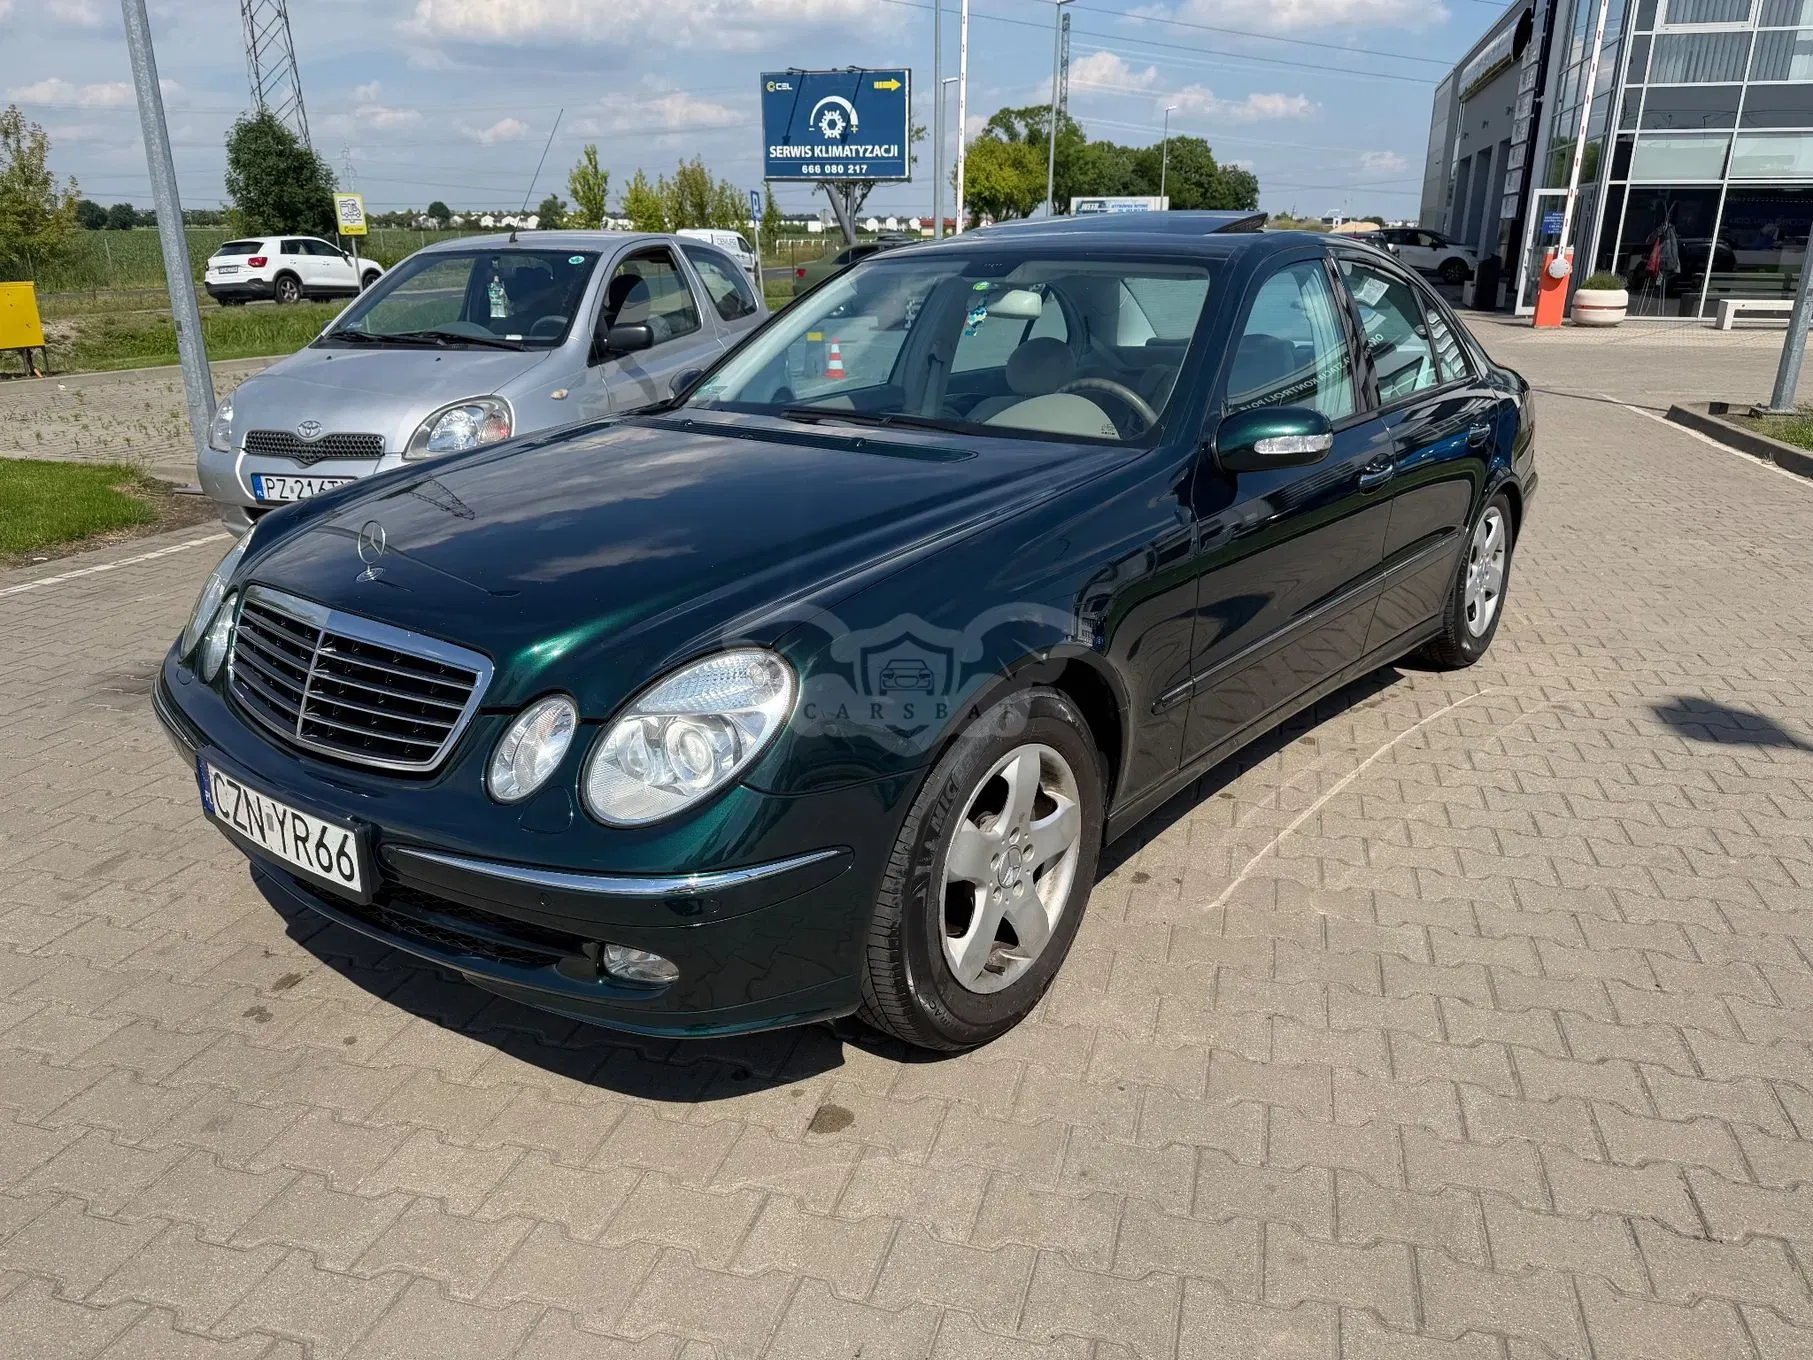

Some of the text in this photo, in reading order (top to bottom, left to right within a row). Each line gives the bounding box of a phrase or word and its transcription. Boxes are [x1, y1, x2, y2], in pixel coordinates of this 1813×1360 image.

[769, 144, 898, 158] SERWIS KLIMATYZACJI
[801, 164, 868, 174] 666 080 217
[264, 477, 346, 500] PZ 216T
[213, 771, 356, 883] CZN YR66
